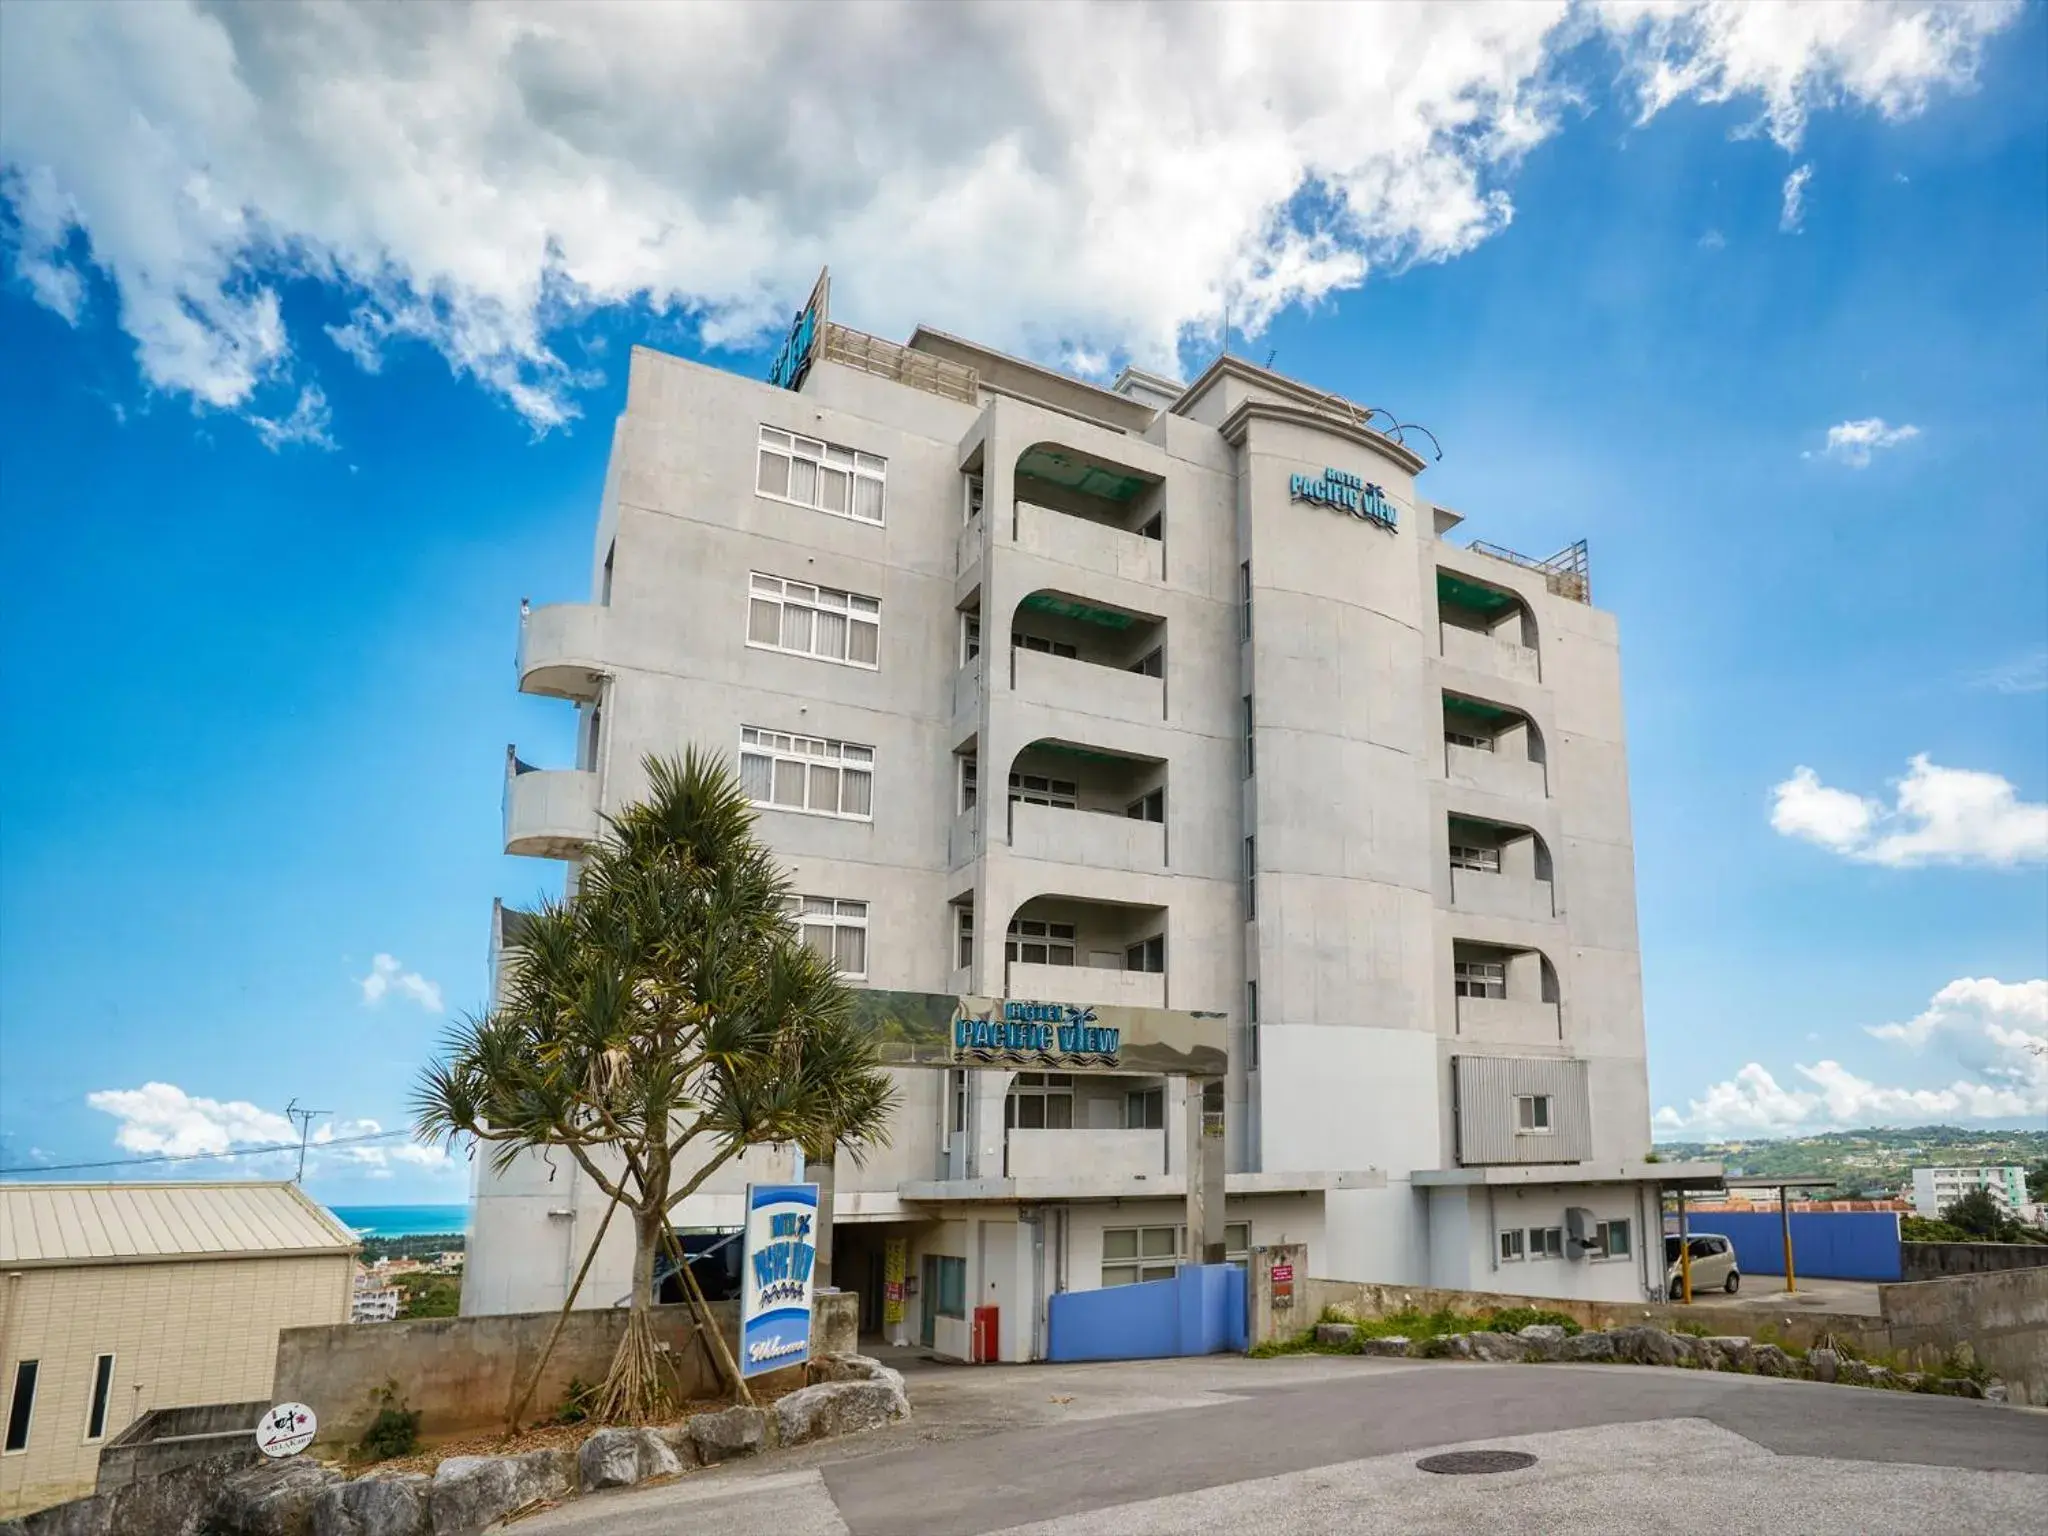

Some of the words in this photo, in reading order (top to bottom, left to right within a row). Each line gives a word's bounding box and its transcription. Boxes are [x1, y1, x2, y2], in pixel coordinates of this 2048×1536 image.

[1290, 473, 1358, 510] PACIFIC
[1362, 490, 1397, 526] VIEW
[1004, 1002, 1063, 1022] HOTEL
[956, 1019, 1055, 1051] PACIFIC
[1056, 1025, 1120, 1053] VIEW
